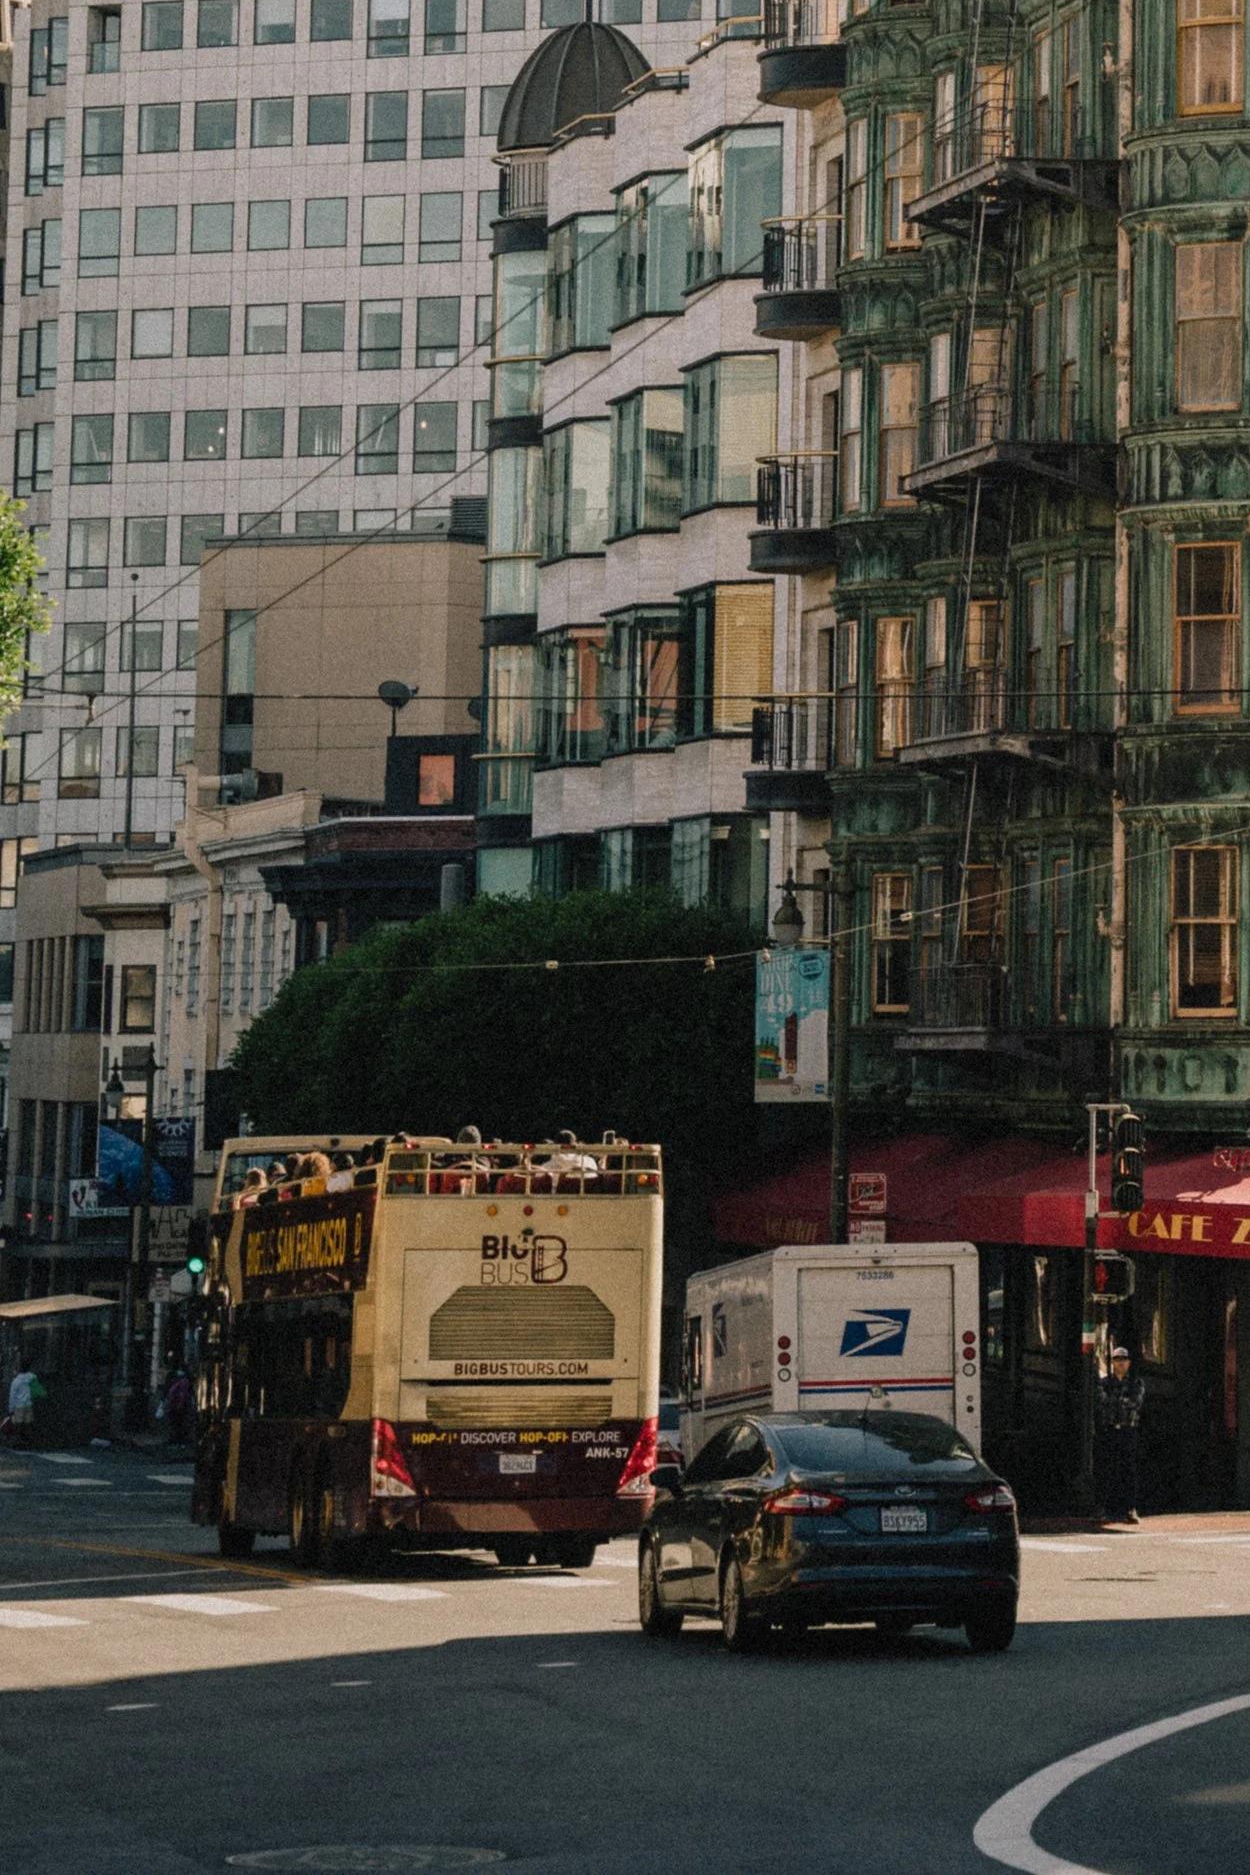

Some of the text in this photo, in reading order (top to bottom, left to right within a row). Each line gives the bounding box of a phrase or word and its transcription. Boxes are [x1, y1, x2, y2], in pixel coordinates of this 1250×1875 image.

[1128, 1211, 1214, 1242] CAFE
[480, 1262, 529, 1285] BUS
[454, 1362, 589, 1376] BIGBUSTOURS.COM
[460, 1432, 517, 1444] DISCOVER
[571, 1431, 621, 1443] EXPLORE
[585, 1447, 630, 1459] ANK-57
